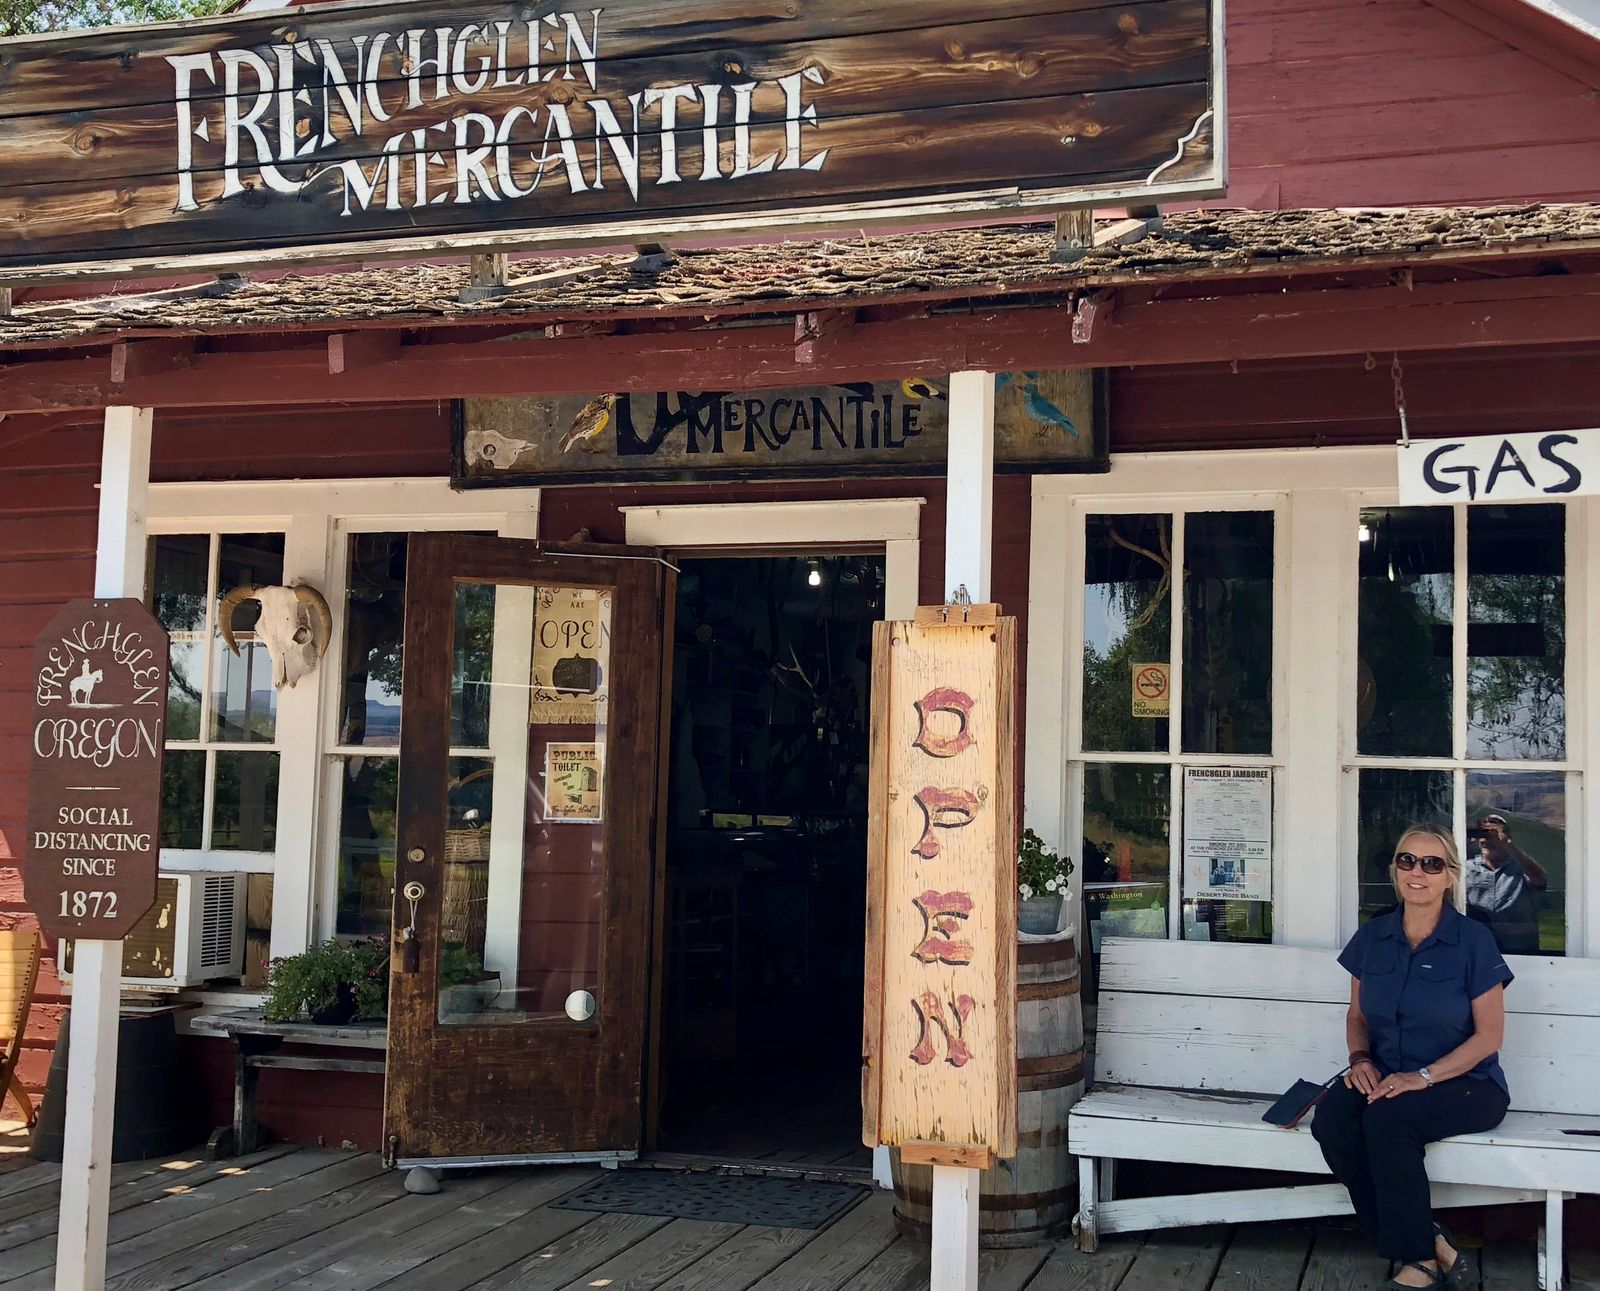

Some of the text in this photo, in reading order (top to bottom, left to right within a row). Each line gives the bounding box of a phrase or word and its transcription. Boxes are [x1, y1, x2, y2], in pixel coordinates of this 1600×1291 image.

[164, 9, 603, 213] FRENCHGLEN
[312, 66, 831, 217] MERCANTILE
[1422, 433, 1582, 500] GAS
[570, 601, 585, 609] ARE
[36, 620, 161, 707] FRENCHGLEN
[1133, 708, 1170, 716] SMOKING
[34, 718, 161, 768] OREGON
[552, 750, 598, 761] PUBLIC
[551, 762, 582, 772] TOILET
[1188, 769, 1269, 779] FRENCHGLEN JAMBOREE
[58, 806, 134, 826] SOCIAL
[34, 831, 151, 853] DISTANCING
[62, 858, 116, 877] SINCE
[911, 686, 979, 1068] OPEN
[57, 890, 119, 918] 1872
[1098, 891, 1144, 901] Washington
